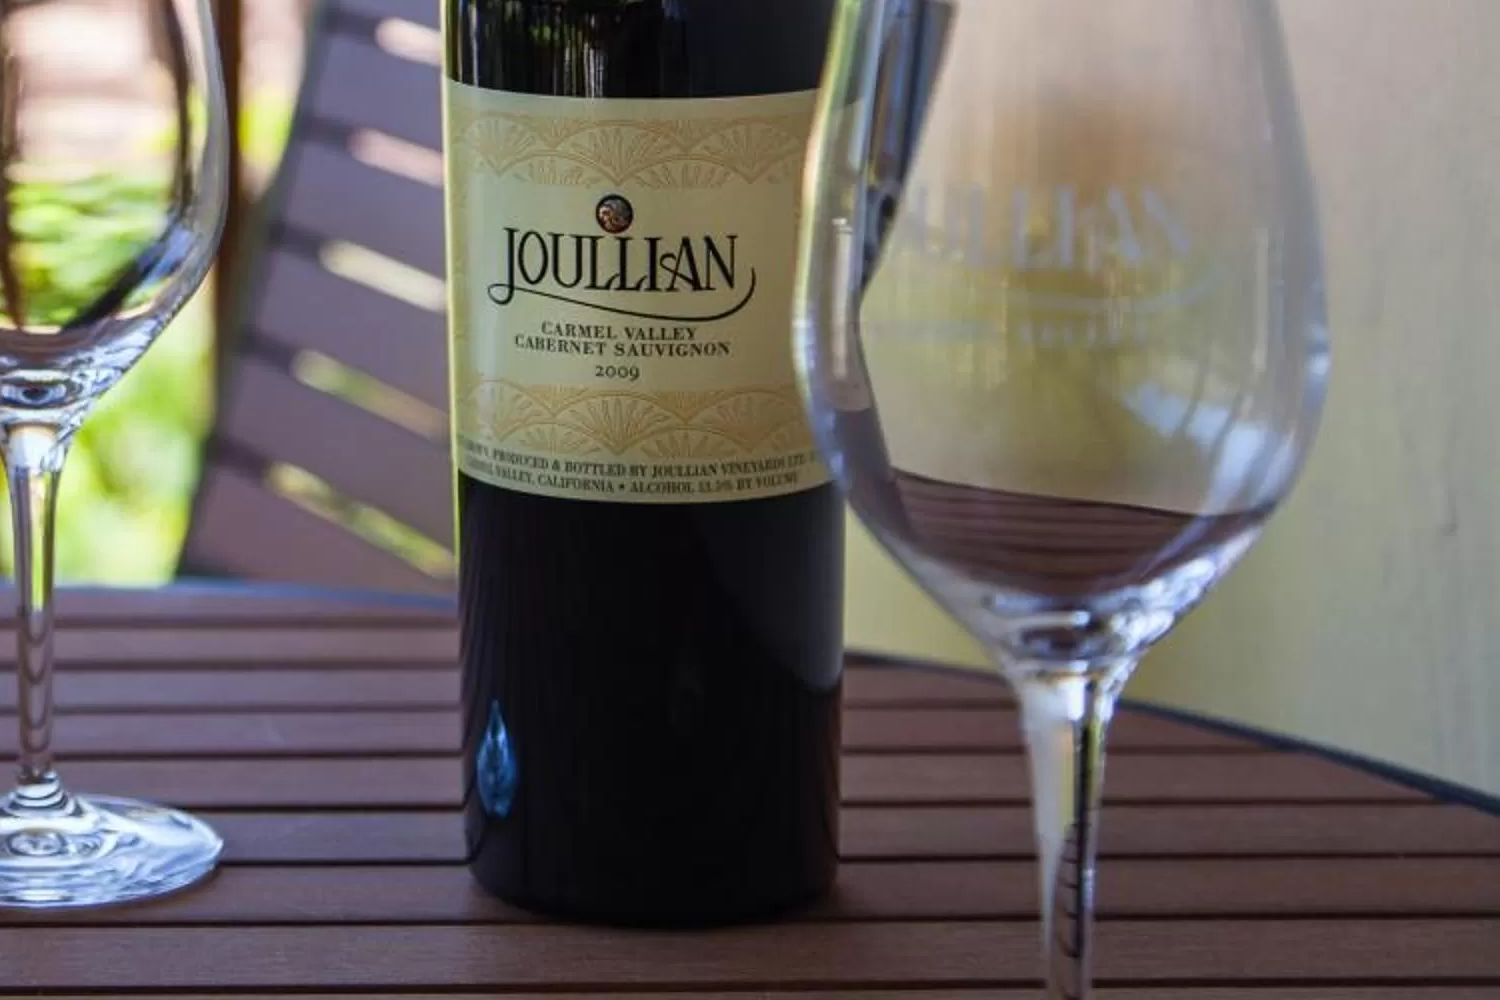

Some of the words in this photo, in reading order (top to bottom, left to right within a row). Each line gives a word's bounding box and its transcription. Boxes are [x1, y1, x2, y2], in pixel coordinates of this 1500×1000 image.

[488, 228, 740, 305] JOULLIAN
[541, 320, 618, 340] CARMEL
[624, 326, 697, 341] VALLEY
[515, 333, 607, 355] CABERNET
[613, 341, 733, 358] SAUVIGNON
[595, 365, 641, 381] 2009
[551, 460, 561, 472] &
[565, 461, 627, 477] BOTTLED
[629, 464, 648, 477] BY
[651, 462, 718, 478] JOULLIAN
[537, 474, 615, 493] CALIFORNIA
